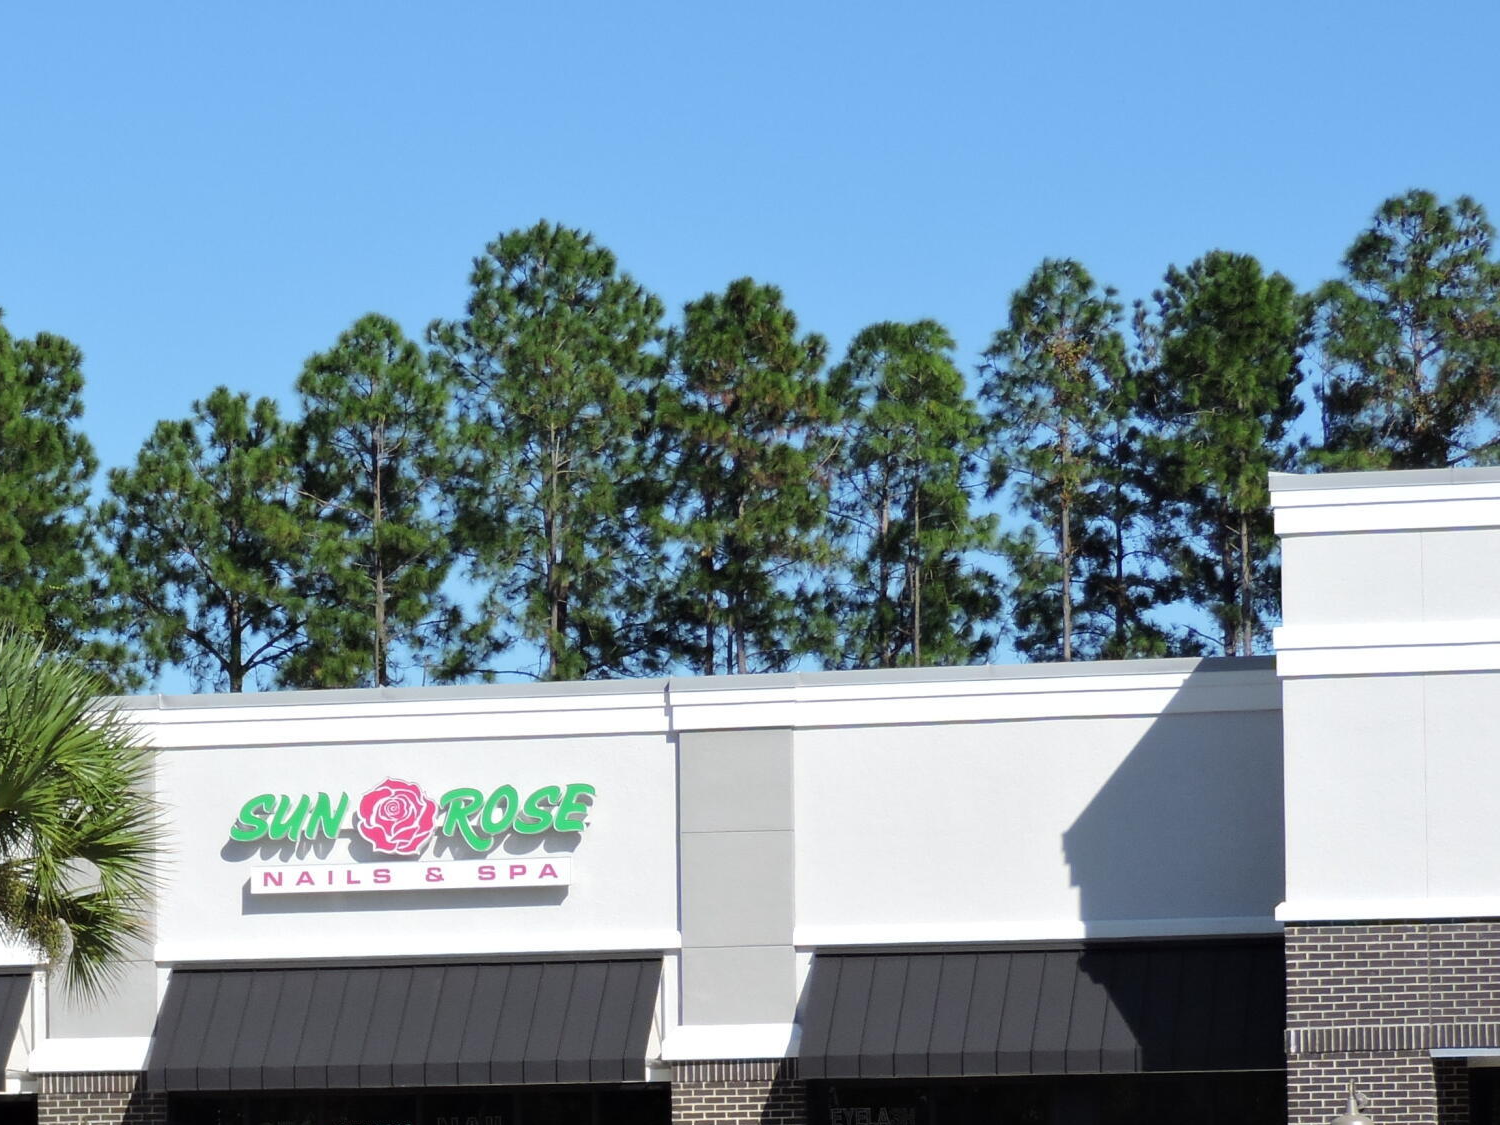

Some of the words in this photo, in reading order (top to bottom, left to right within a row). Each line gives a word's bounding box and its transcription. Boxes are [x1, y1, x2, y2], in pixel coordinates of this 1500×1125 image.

[228, 791, 349, 842] SUN
[437, 782, 598, 852] ROSE
[262, 867, 392, 888] NAILS
[425, 866, 445, 883] &
[477, 862, 559, 882] SPA
